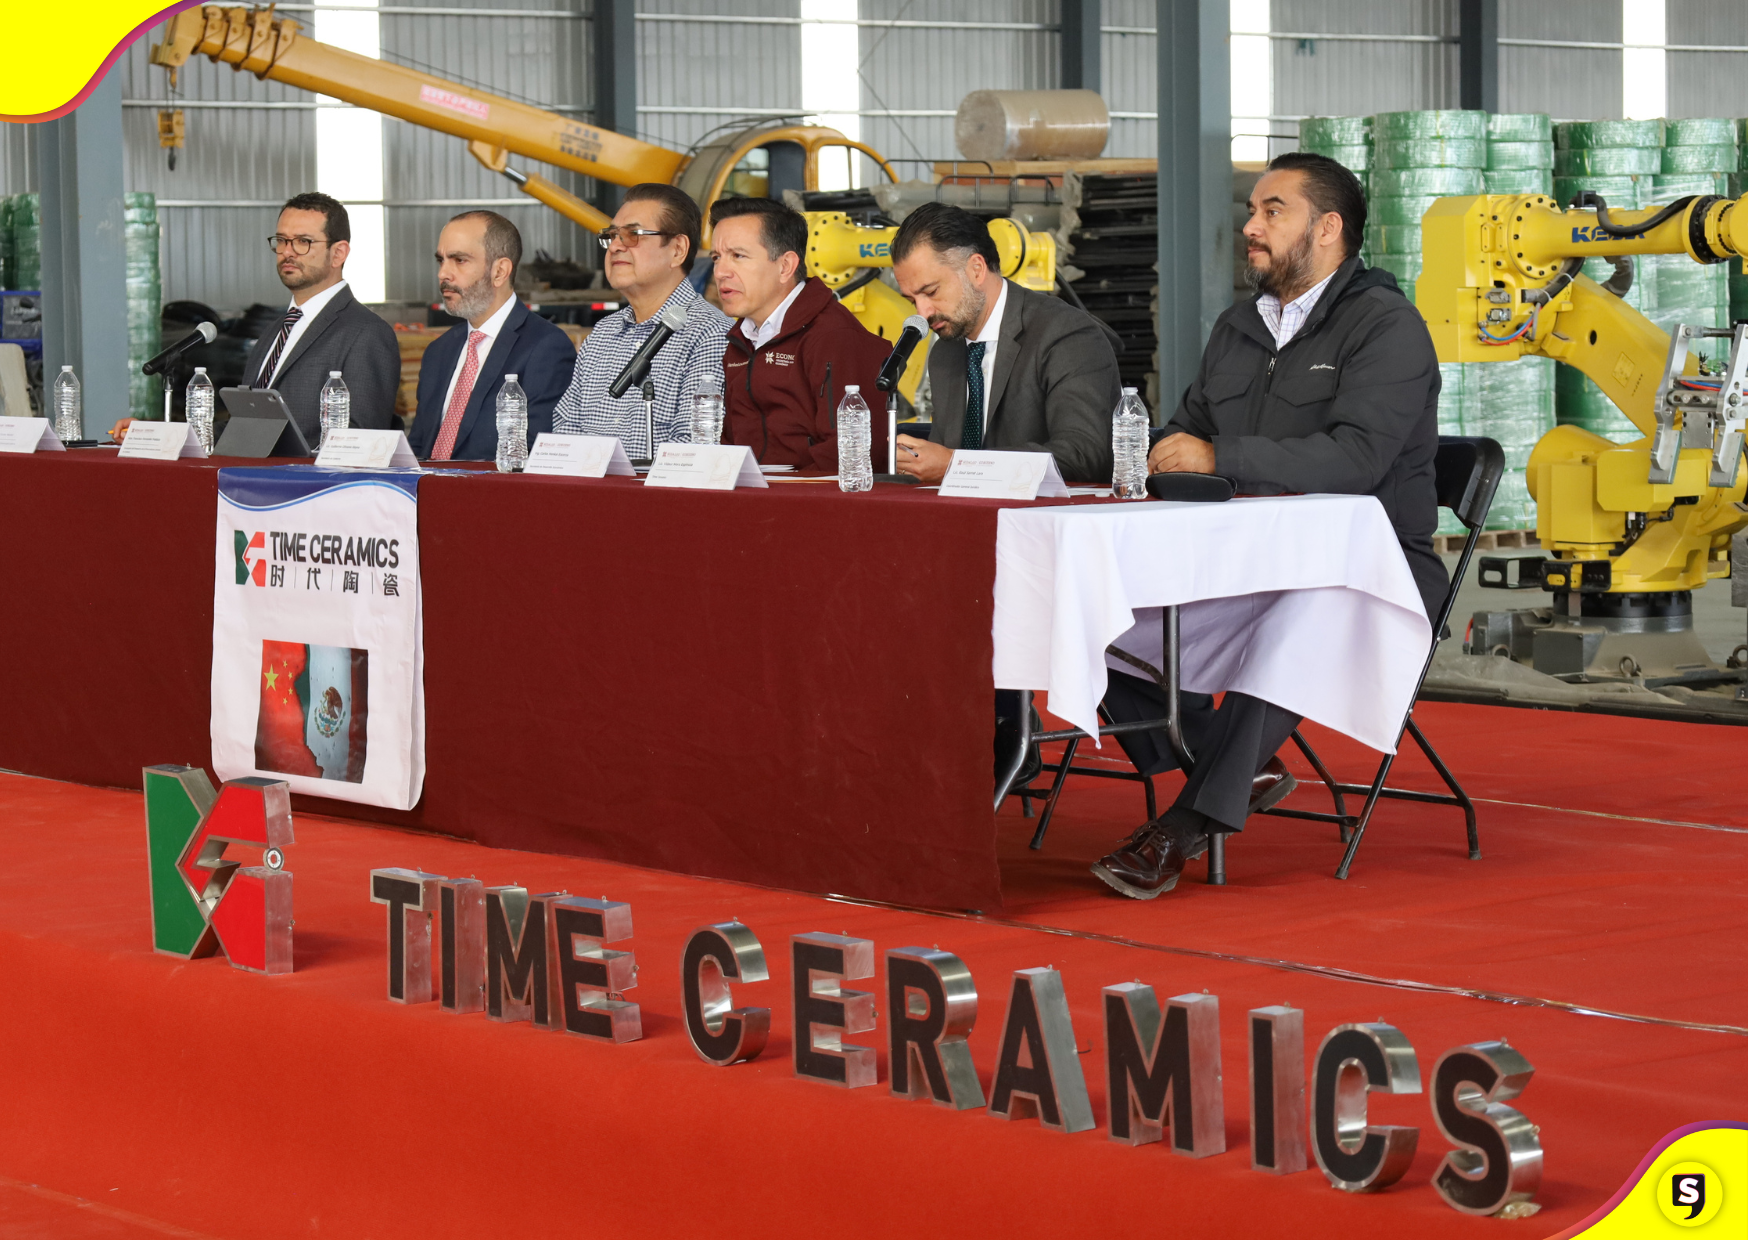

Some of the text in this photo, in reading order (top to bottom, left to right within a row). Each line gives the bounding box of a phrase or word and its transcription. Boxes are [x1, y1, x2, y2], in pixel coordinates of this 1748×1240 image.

[270, 531, 400, 569] TIME CERAMICS
[370, 867, 1544, 1217] TIME CERAMICS
